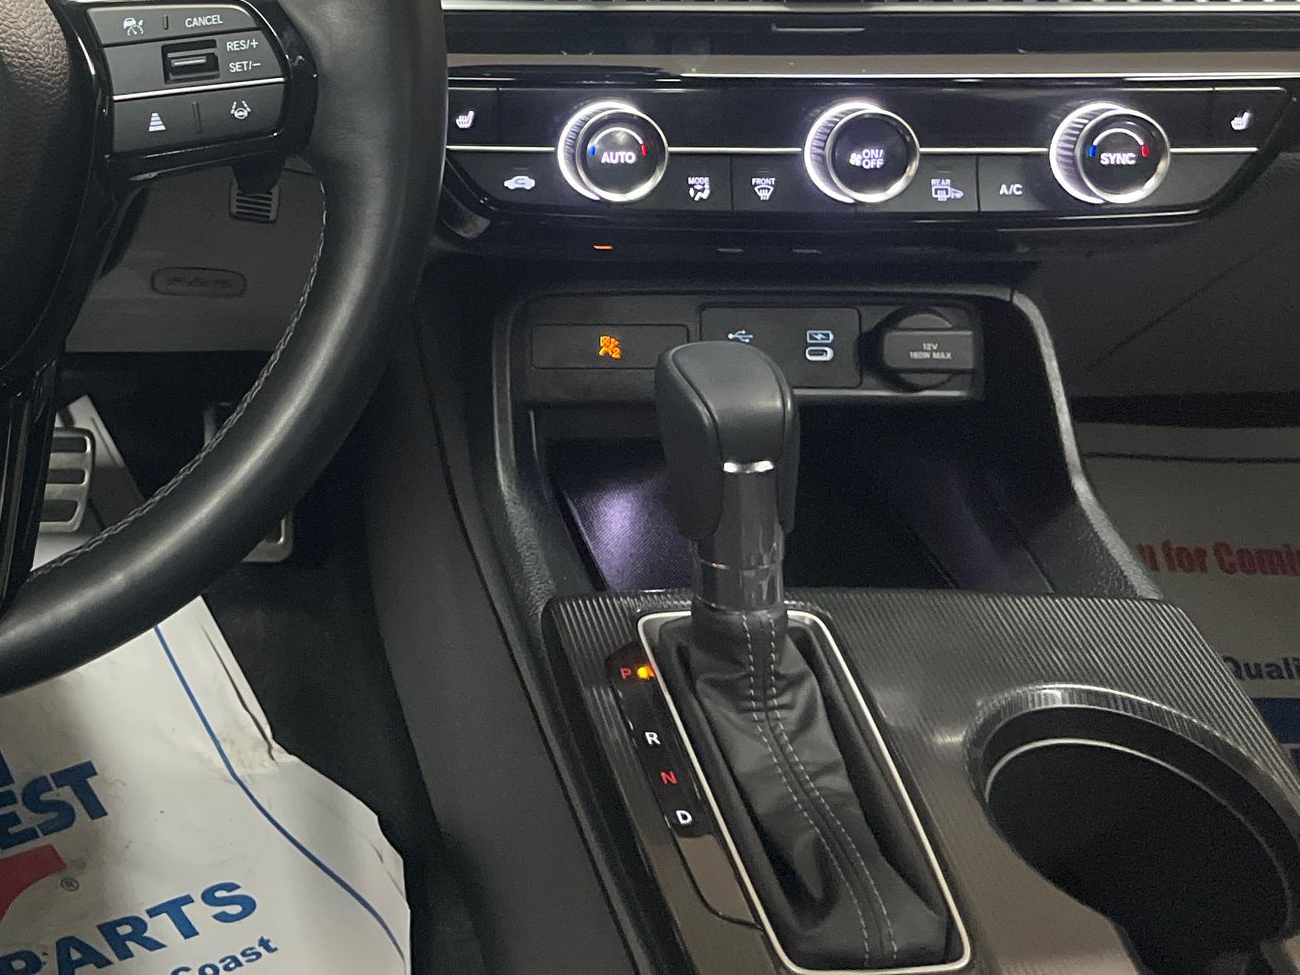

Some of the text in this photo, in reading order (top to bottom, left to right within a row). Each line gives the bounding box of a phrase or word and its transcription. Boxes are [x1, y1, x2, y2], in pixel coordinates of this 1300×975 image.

[185, 14, 224, 28] CANCEL
[600, 151, 636, 164] AUTO
[862, 159, 884, 169] OFF
[1100, 152, 1137, 165] SYNC
[687, 176, 710, 185] MODE
[751, 177, 776, 186] FRONT
[930, 178, 951, 186] REAR
[999, 183, 1023, 196] A/C
[932, 351, 952, 360] MAX
[1161, 539, 1207, 573] for
[620, 667, 631, 680] P
[644, 731, 661, 746] R
[660, 770, 678, 785] N
[675, 809, 693, 825] D
